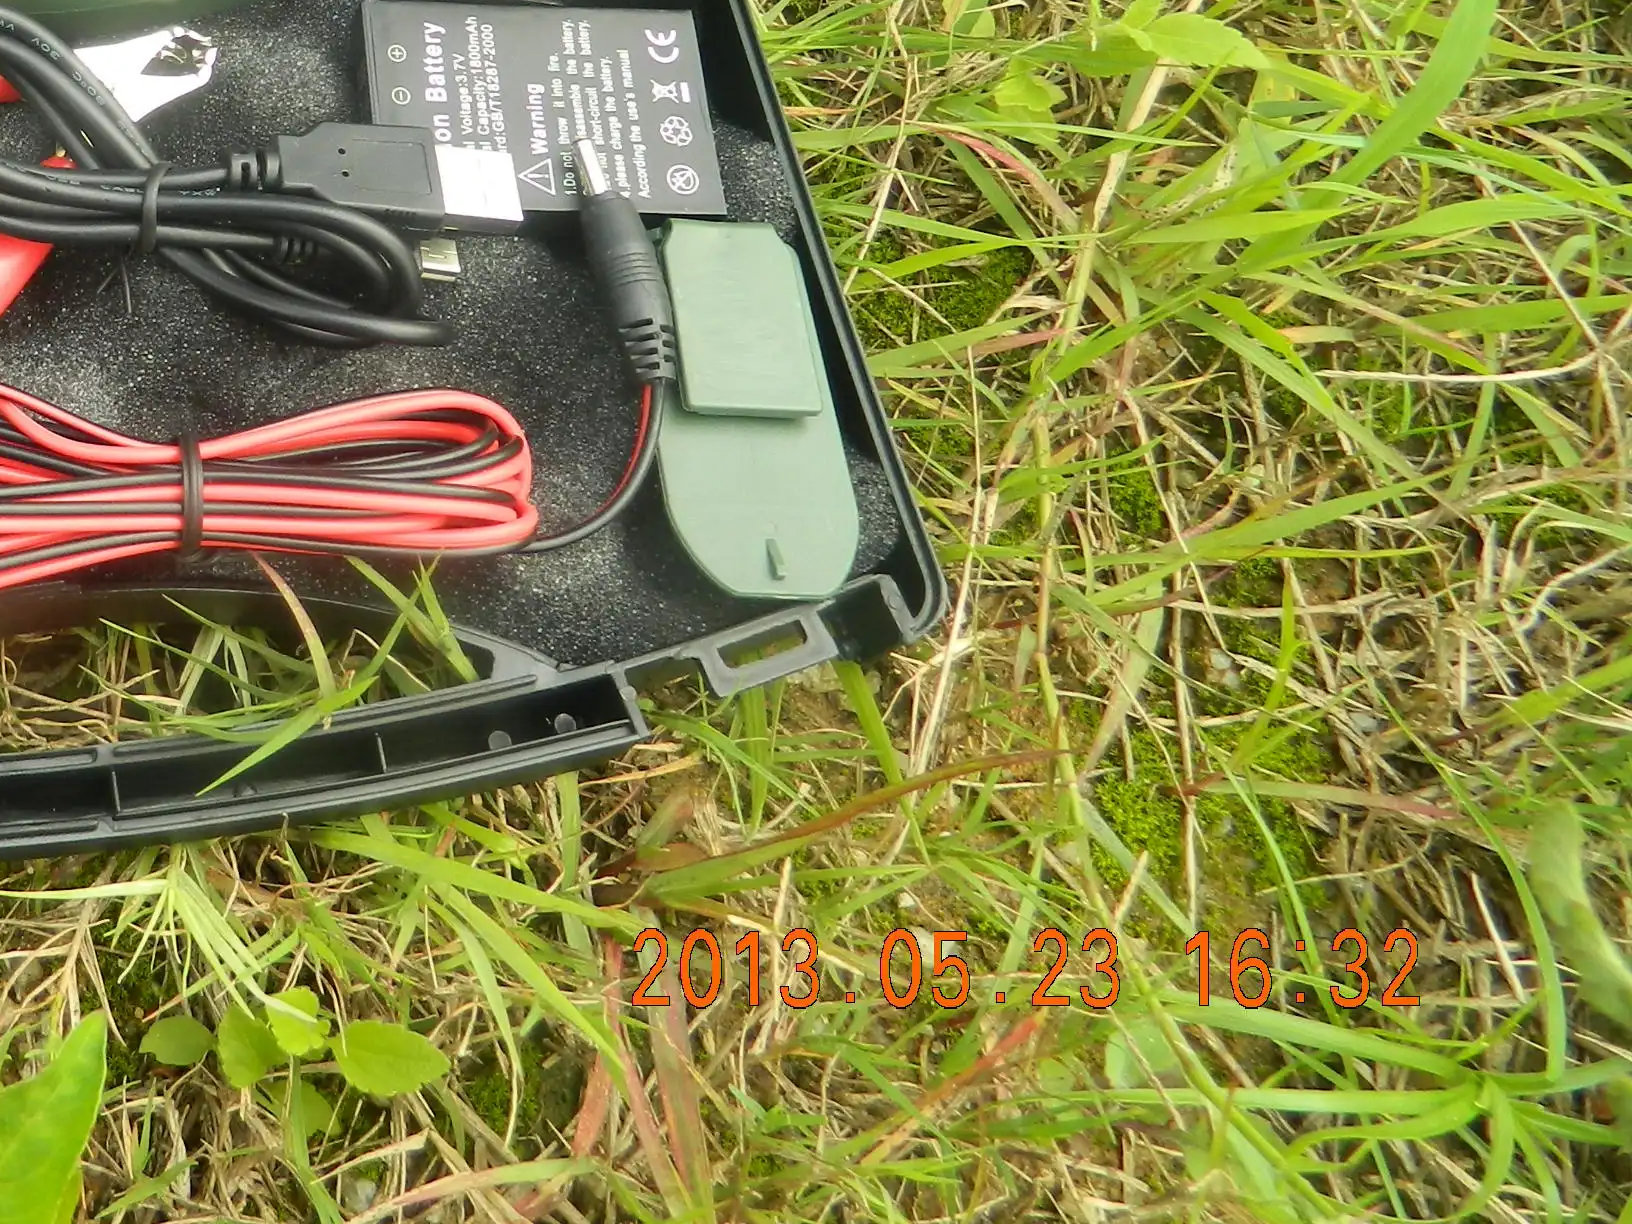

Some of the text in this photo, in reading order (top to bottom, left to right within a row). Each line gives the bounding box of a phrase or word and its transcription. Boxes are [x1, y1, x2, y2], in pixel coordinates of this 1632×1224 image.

[561, 19, 576, 55] battery.
[578, 19, 593, 56] battery.
[423, 22, 448, 103] Battery
[464, 16, 490, 136] Capacity:1800mAh
[566, 58, 578, 75] the
[582, 61, 595, 78] the
[600, 56, 614, 93] battery.
[452, 53, 474, 135] Voltage:3.7V
[551, 78, 564, 97] into
[604, 96, 617, 112] the
[526, 83, 549, 155] Warning
[557, 117, 570, 145] throw
[584, 87, 605, 146] short-circuit
[608, 116, 623, 151] charge
[615, 49, 652, 198] According the use's manual
[559, 151, 574, 168] not
[562, 172, 577, 196] 1.Do
